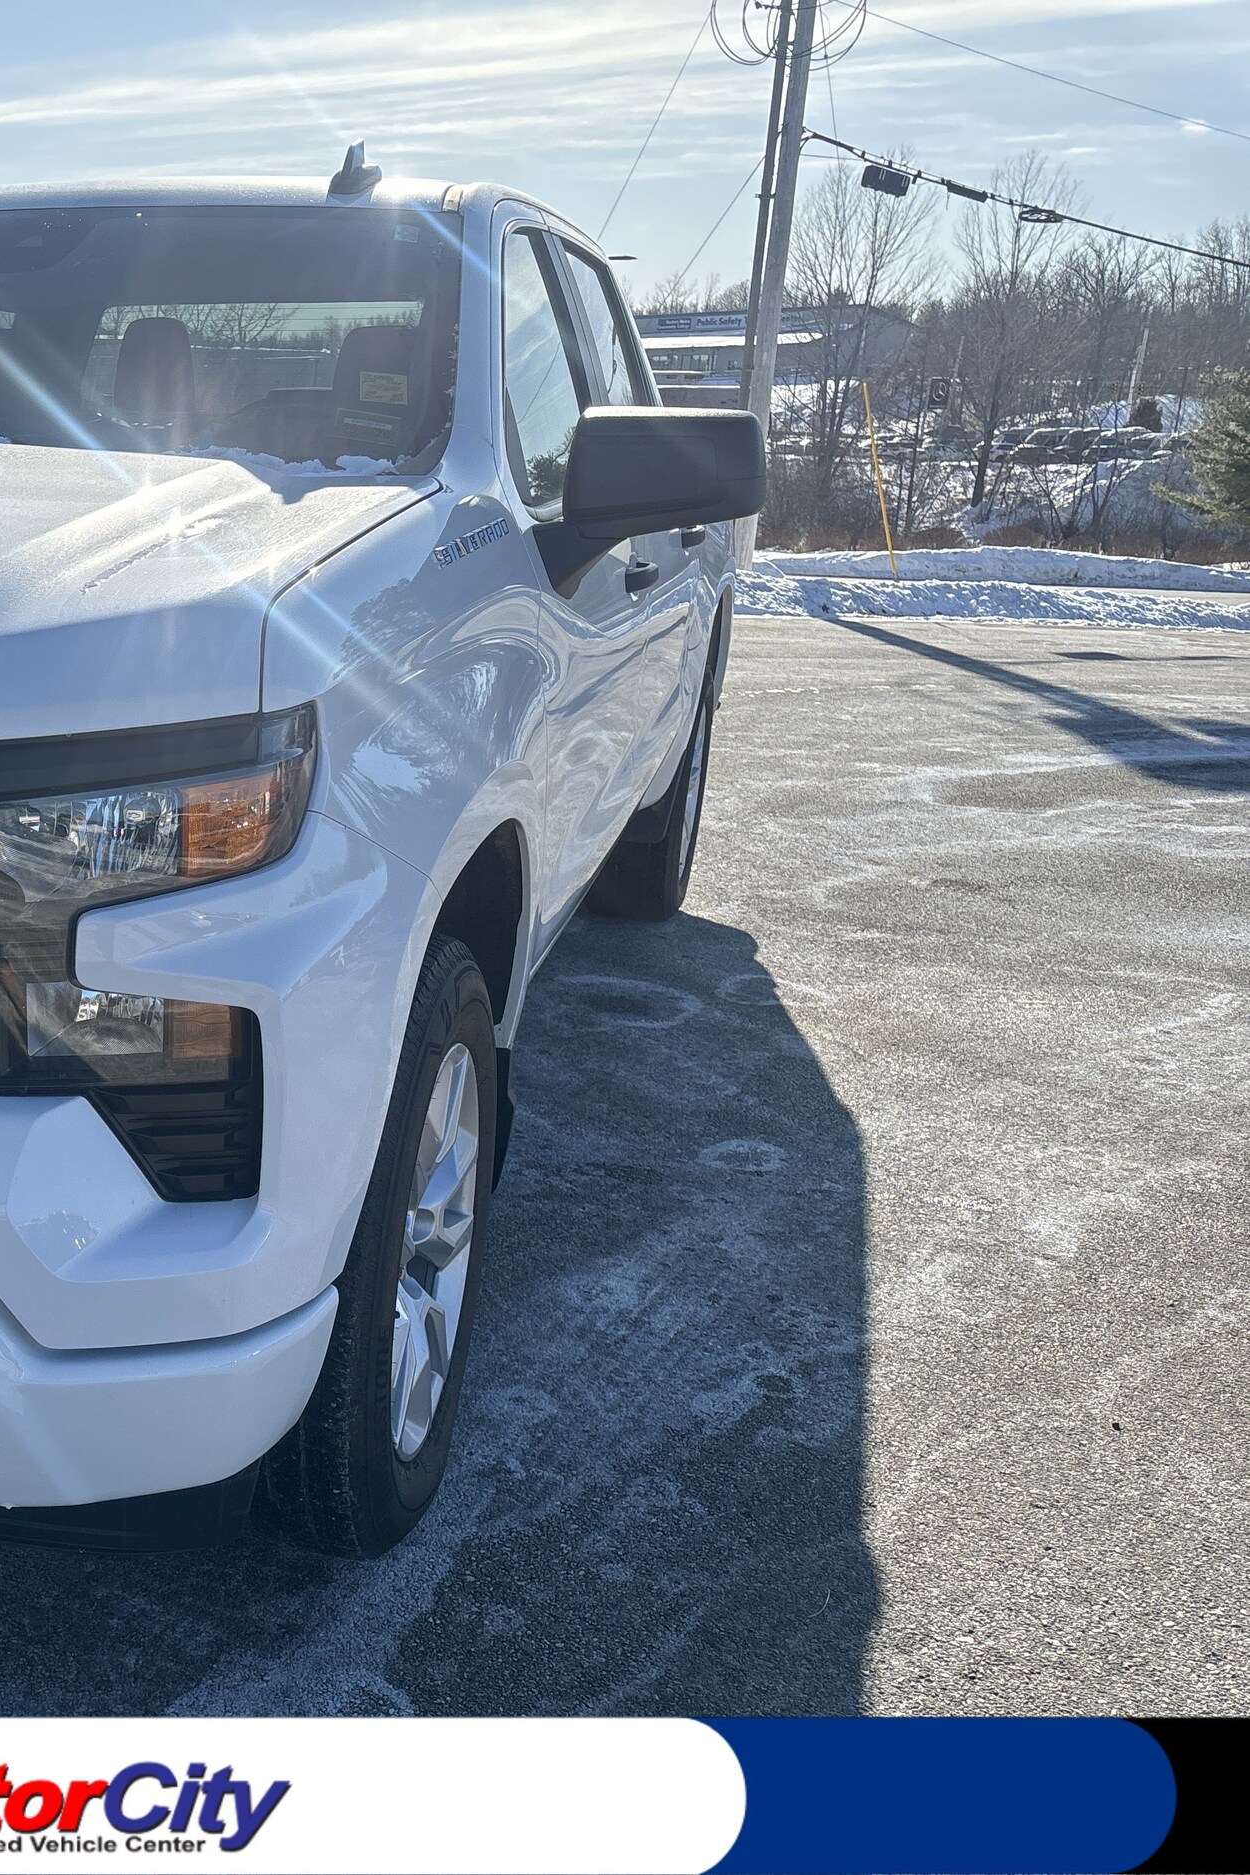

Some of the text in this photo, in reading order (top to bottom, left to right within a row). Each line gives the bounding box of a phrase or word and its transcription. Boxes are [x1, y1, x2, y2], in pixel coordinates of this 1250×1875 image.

[696, 317, 718, 326] Public
[719, 317, 742, 327] Safety
[433, 517, 510, 570] SILVERADO
